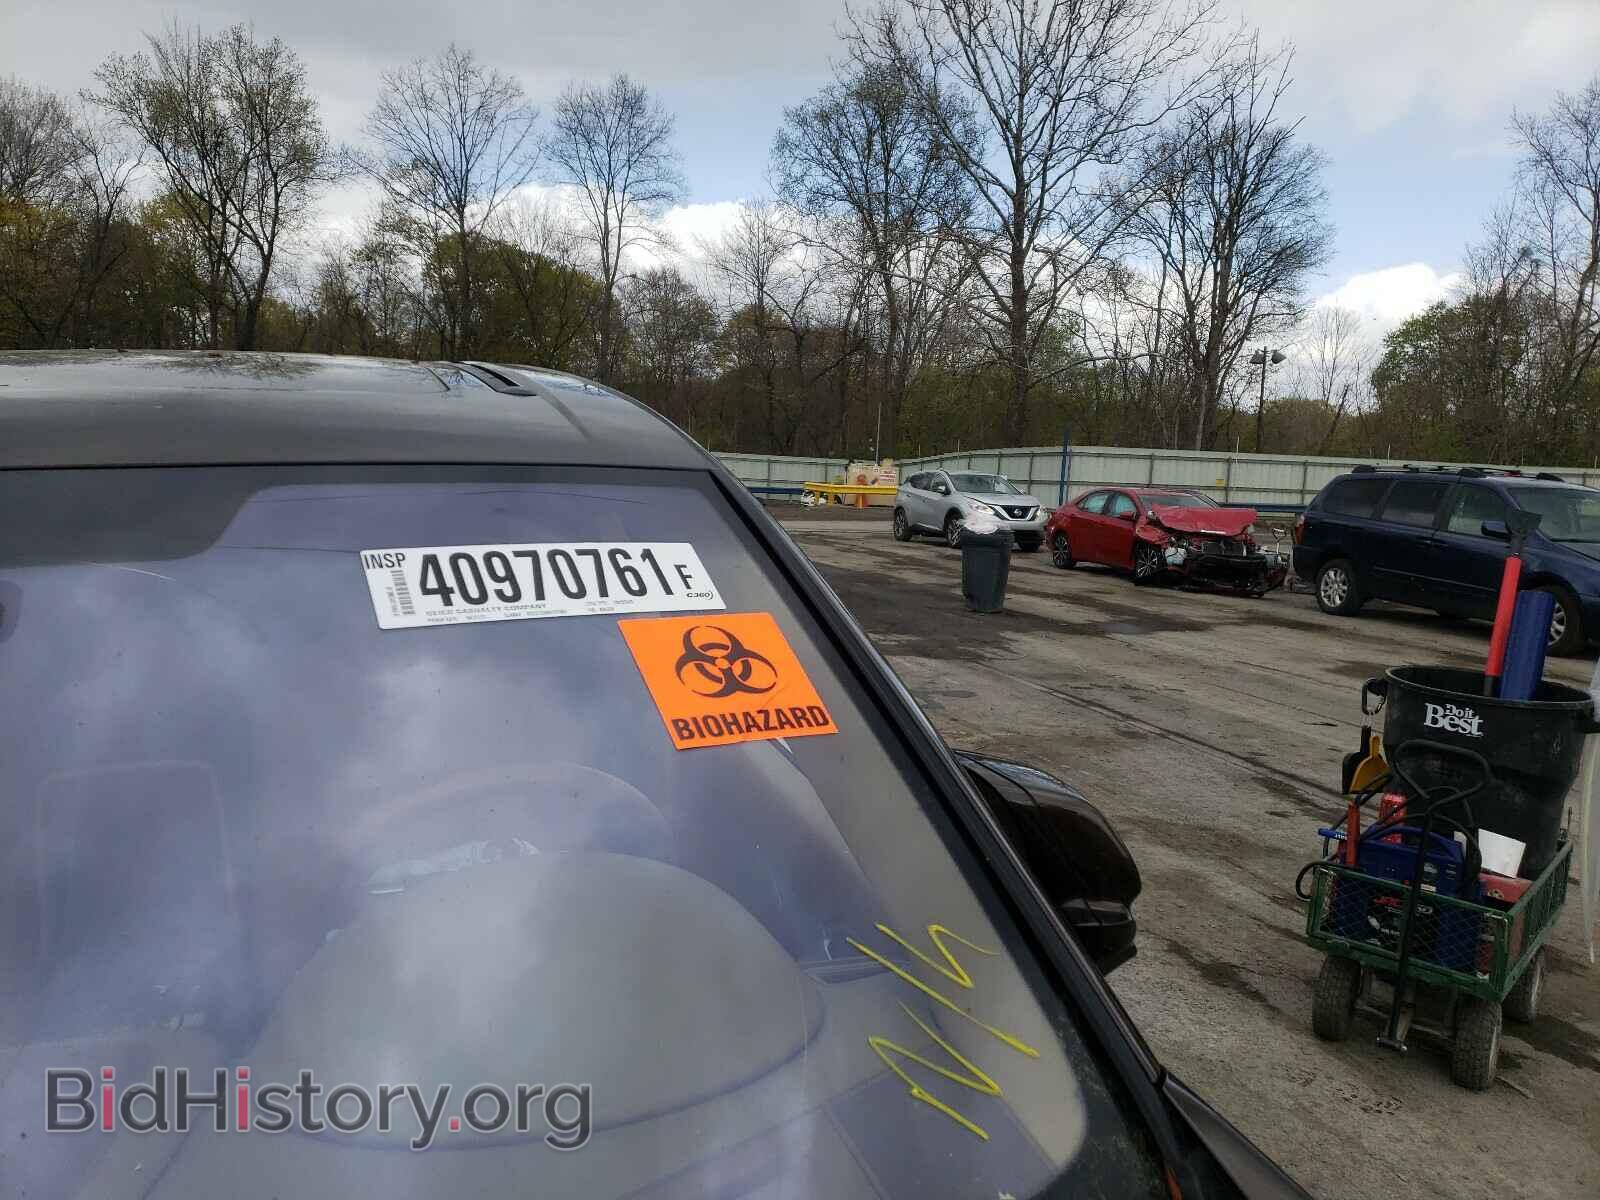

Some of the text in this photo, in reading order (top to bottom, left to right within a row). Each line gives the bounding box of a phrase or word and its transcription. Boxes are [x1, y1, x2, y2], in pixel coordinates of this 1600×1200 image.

[363, 552, 406, 569] INSP
[419, 548, 674, 606] 40970761
[674, 564, 694, 590] F
[671, 705, 830, 741] BIOHAZARD
[1424, 702, 1484, 737] Best
